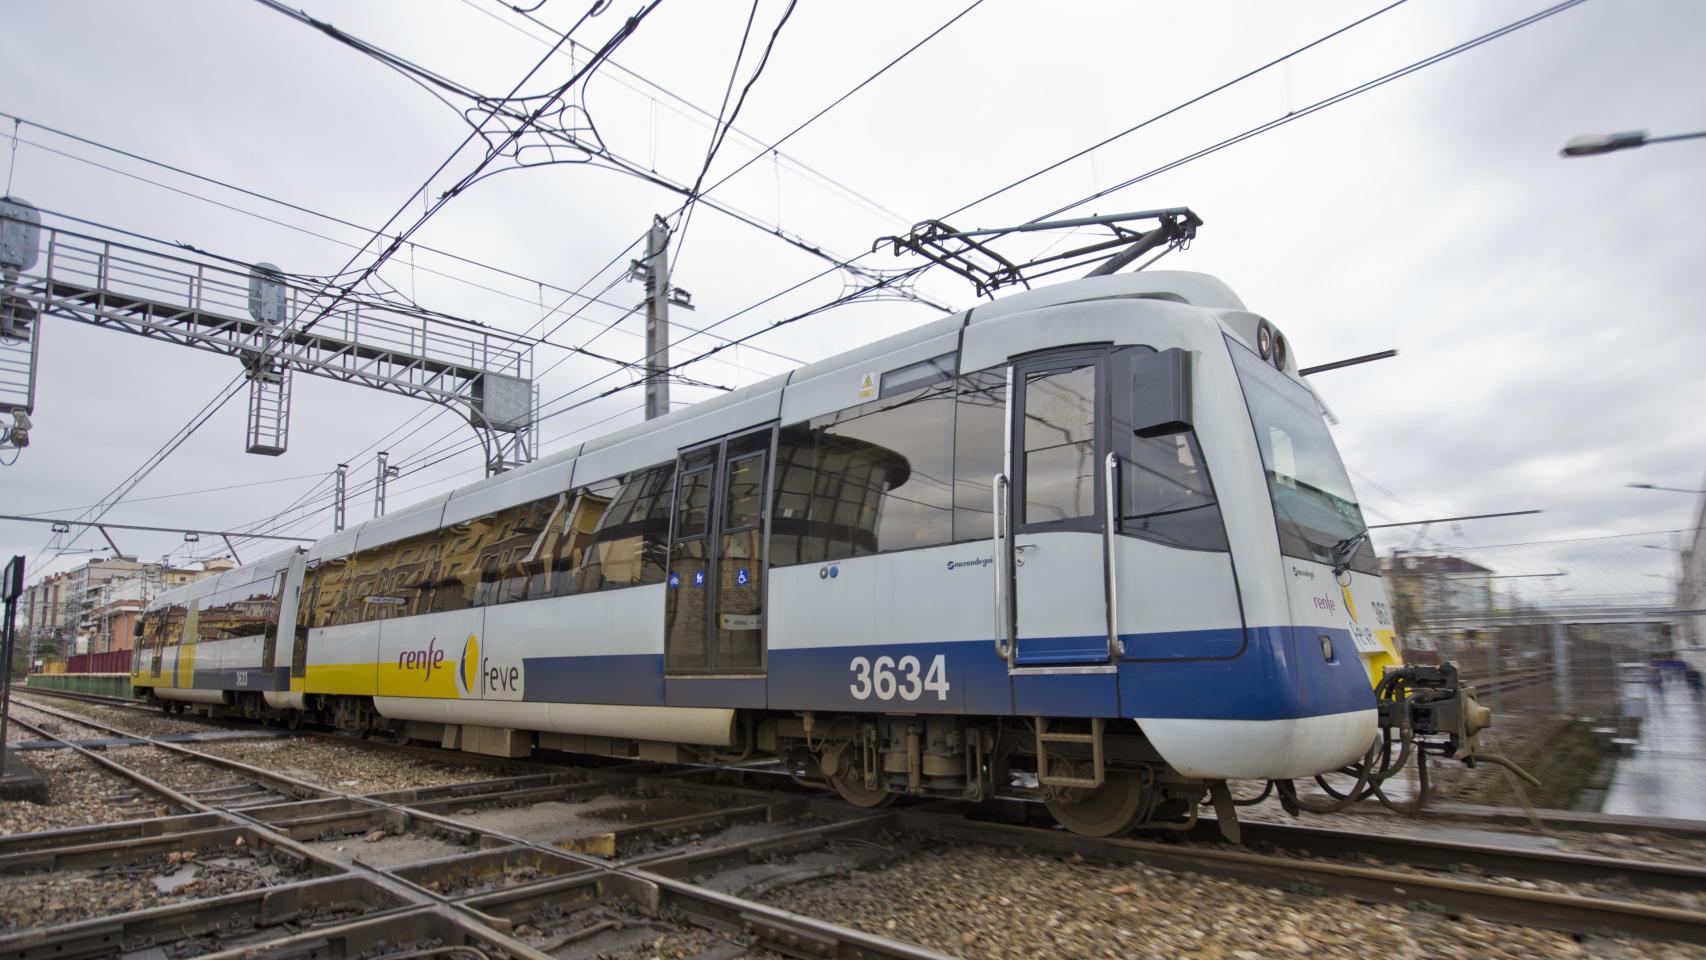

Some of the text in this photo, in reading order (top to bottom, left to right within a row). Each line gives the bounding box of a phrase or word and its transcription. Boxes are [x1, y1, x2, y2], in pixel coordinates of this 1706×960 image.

[1313, 593, 1336, 616] renfe
[398, 637, 445, 682] renfe
[483, 657, 519, 696] feve
[850, 654, 950, 701] 3634
